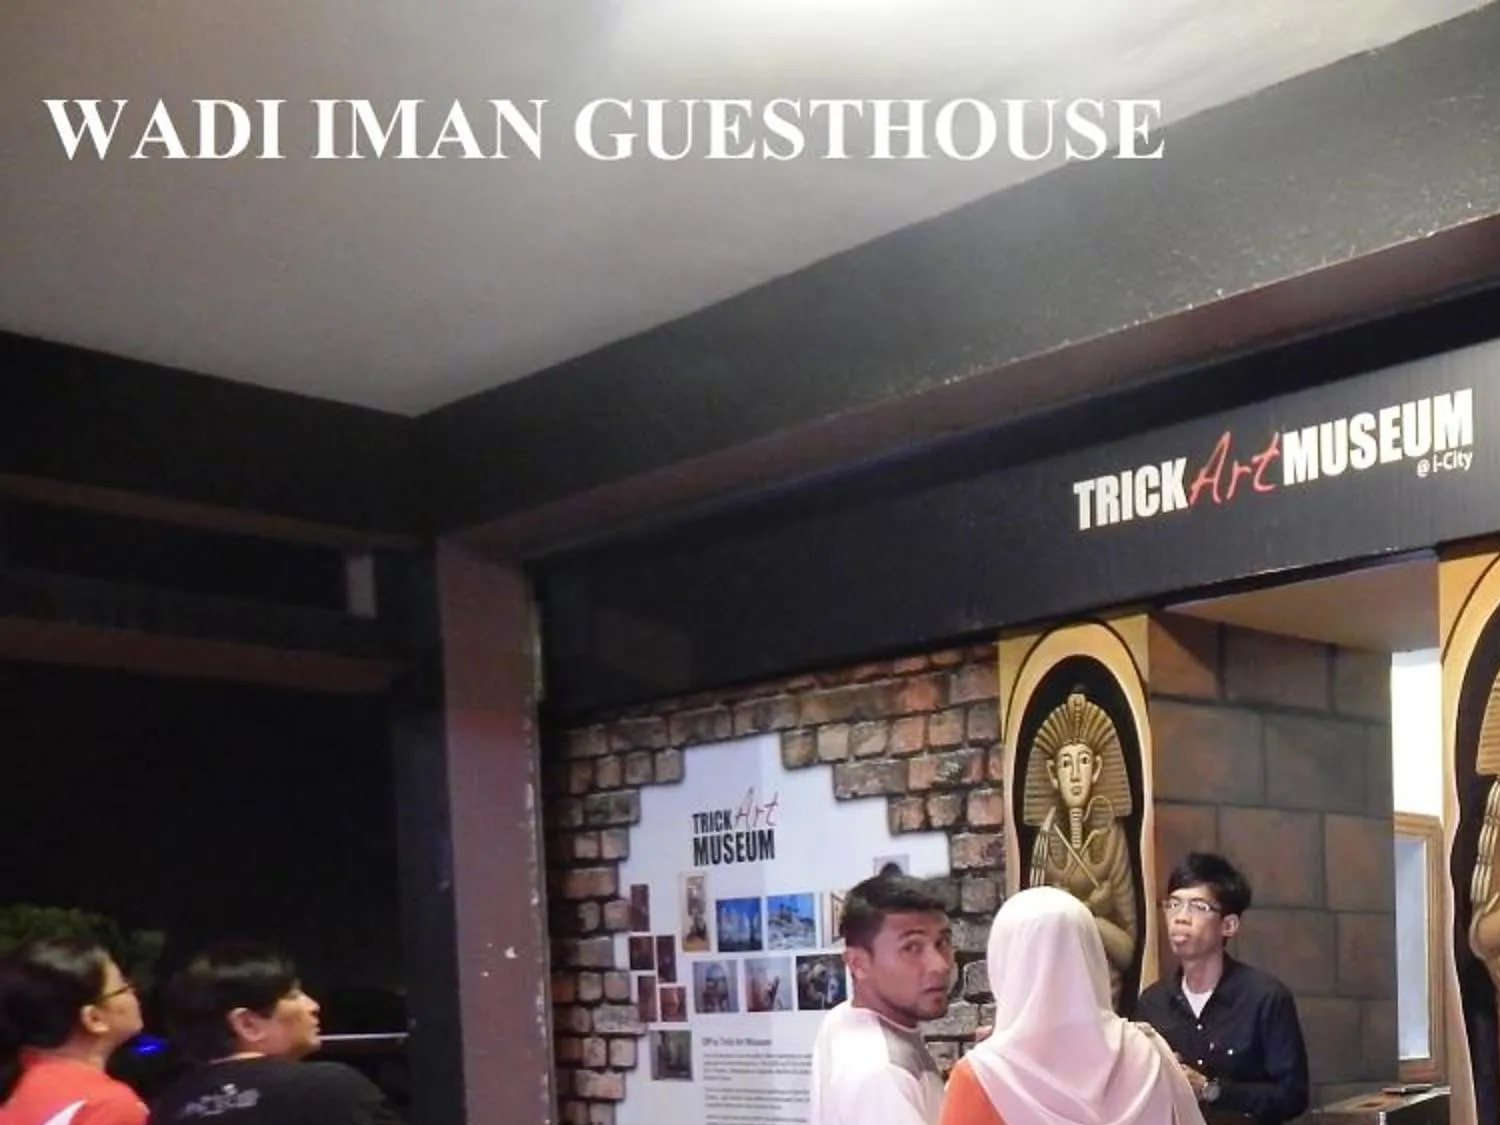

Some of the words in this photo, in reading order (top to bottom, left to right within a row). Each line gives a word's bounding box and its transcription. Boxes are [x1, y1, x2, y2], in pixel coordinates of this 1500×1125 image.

[1073, 456, 1189, 531] TRICK
[1188, 430, 1281, 505] Art
[1283, 388, 1474, 486] MUSEUM
[692, 808, 733, 834] TRICK
[735, 786, 779, 830] Art
[693, 828, 775, 867] MUSEUM
